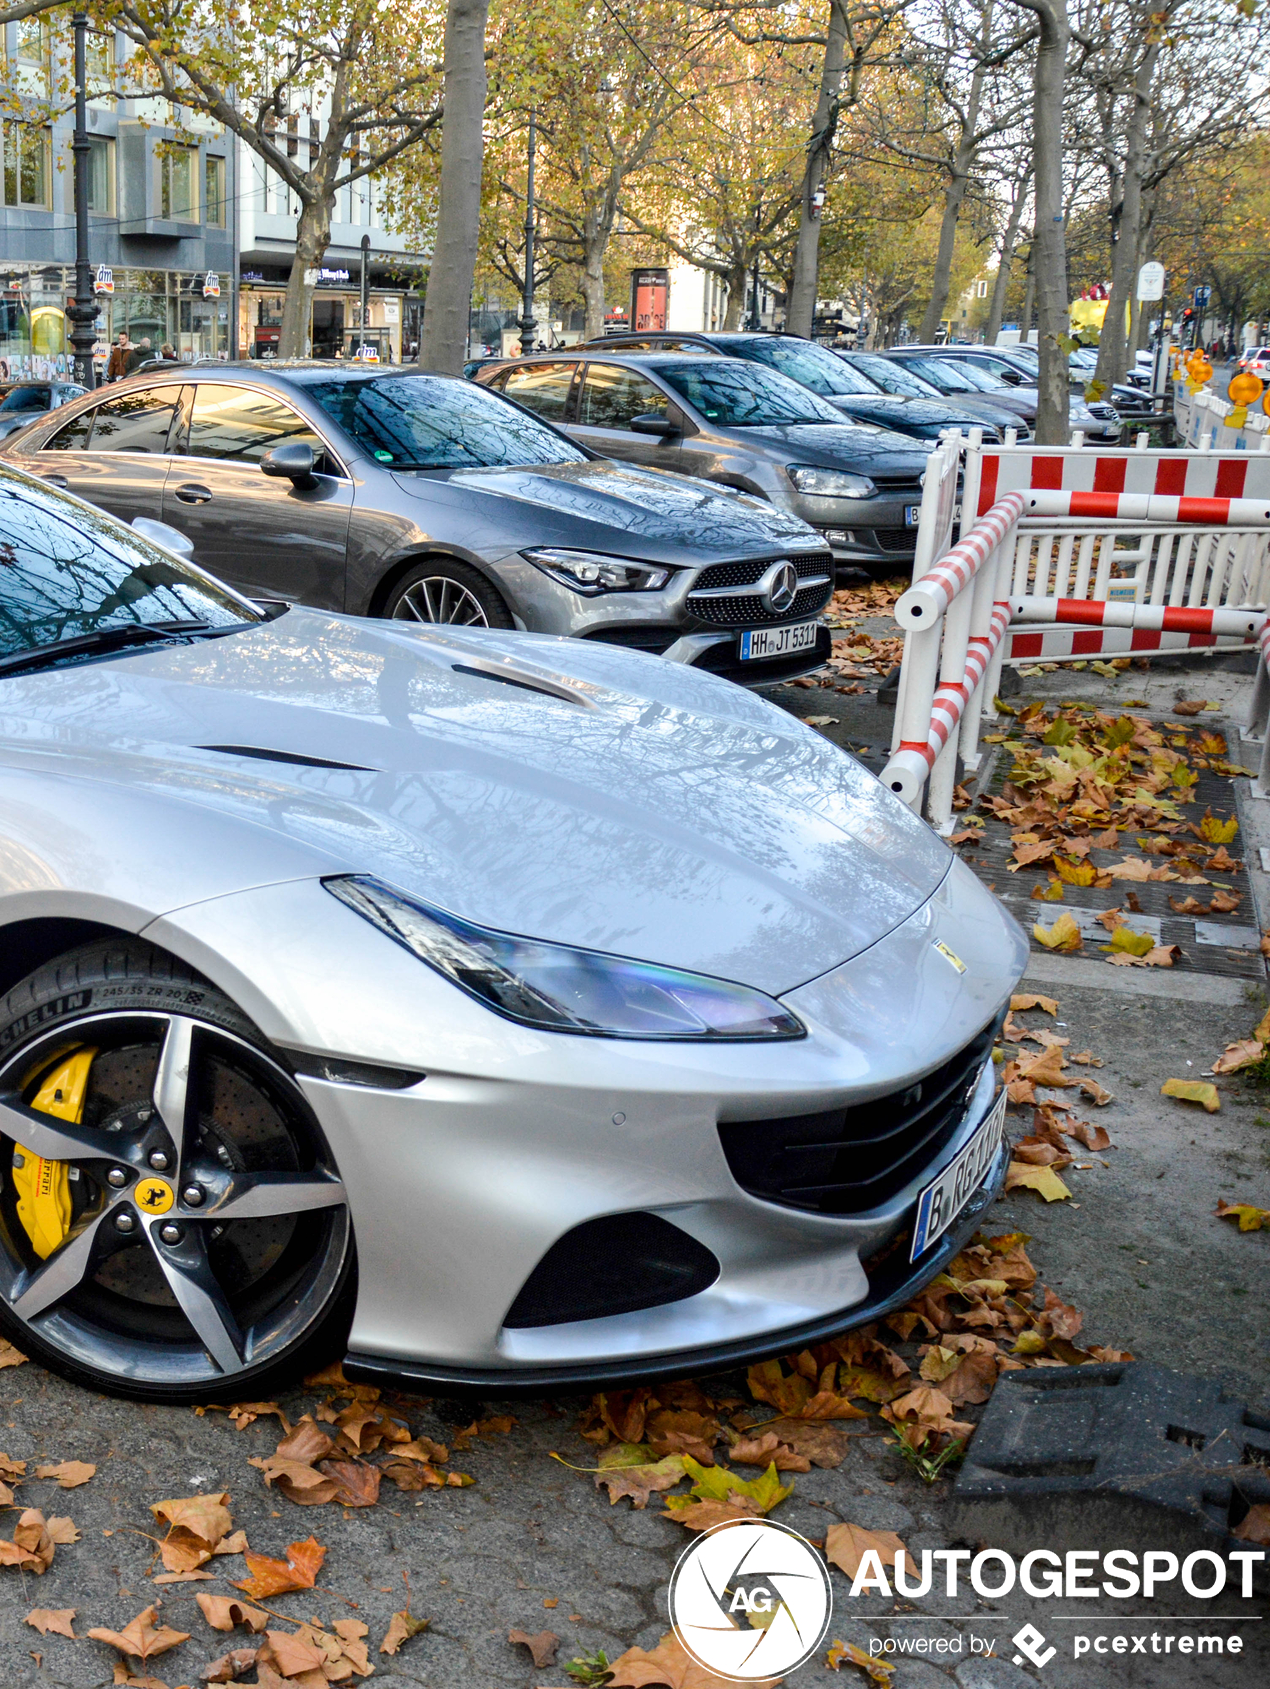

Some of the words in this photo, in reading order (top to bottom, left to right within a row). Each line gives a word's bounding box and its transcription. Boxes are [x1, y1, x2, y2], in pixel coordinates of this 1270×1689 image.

[98, 265, 112, 282] dm
[207, 272, 218, 287] dm
[751, 631, 768, 655] HH
[776, 628, 791, 651] JT
[792, 623, 815, 648] 5311
